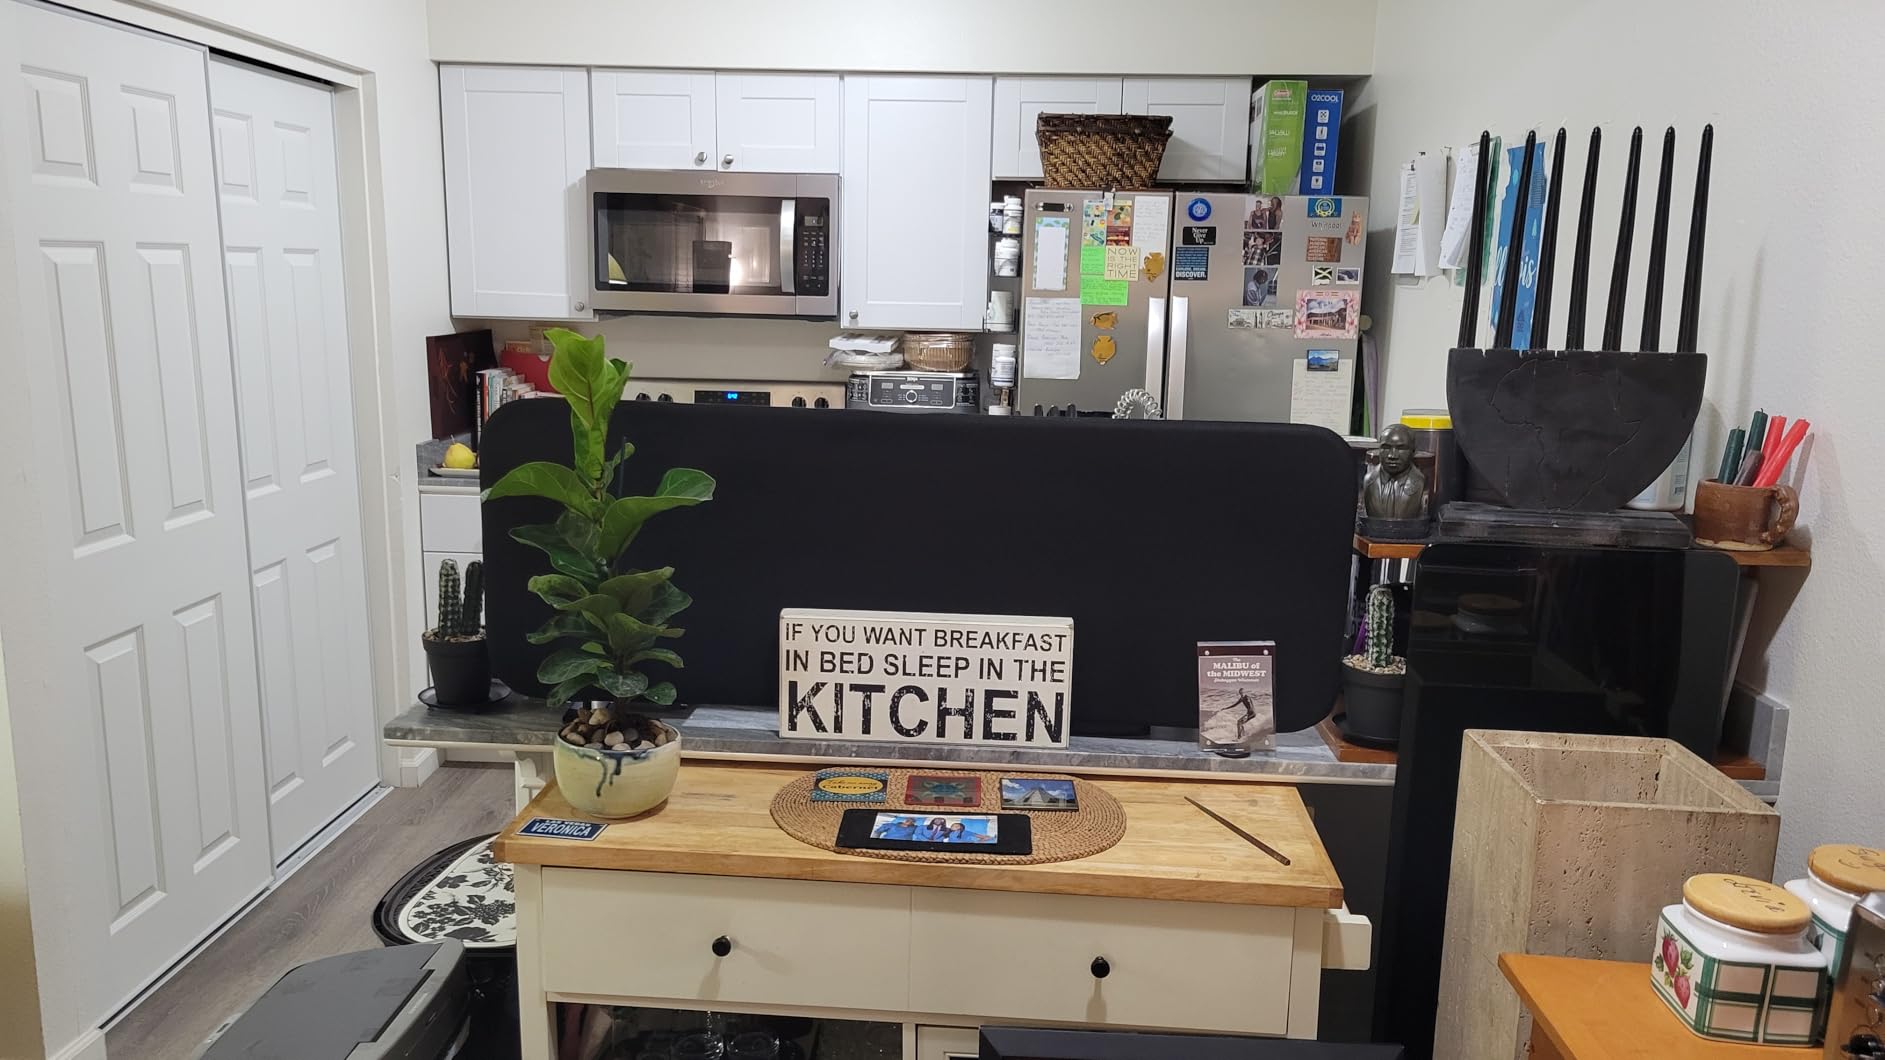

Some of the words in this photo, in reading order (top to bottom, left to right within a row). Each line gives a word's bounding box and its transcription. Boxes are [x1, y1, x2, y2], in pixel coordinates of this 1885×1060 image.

[1311, 94, 1339, 103] O2COOL
[1107, 247, 1138, 255] NOW
[1108, 270, 1137, 279] TIME
[785, 622, 803, 641] IF
[811, 624, 856, 644] YOU
[863, 626, 927, 647] WANT
[934, 629, 1067, 652] BREAKFAST
[785, 649, 809, 672] IN
[820, 652, 874, 675] BED
[883, 653, 970, 679] SLEEP
[979, 657, 1003, 681] IN
[1013, 659, 1066, 683] THE
[787, 680, 1065, 744] KITCHEN
[531, 822, 592, 836] VERONICA
